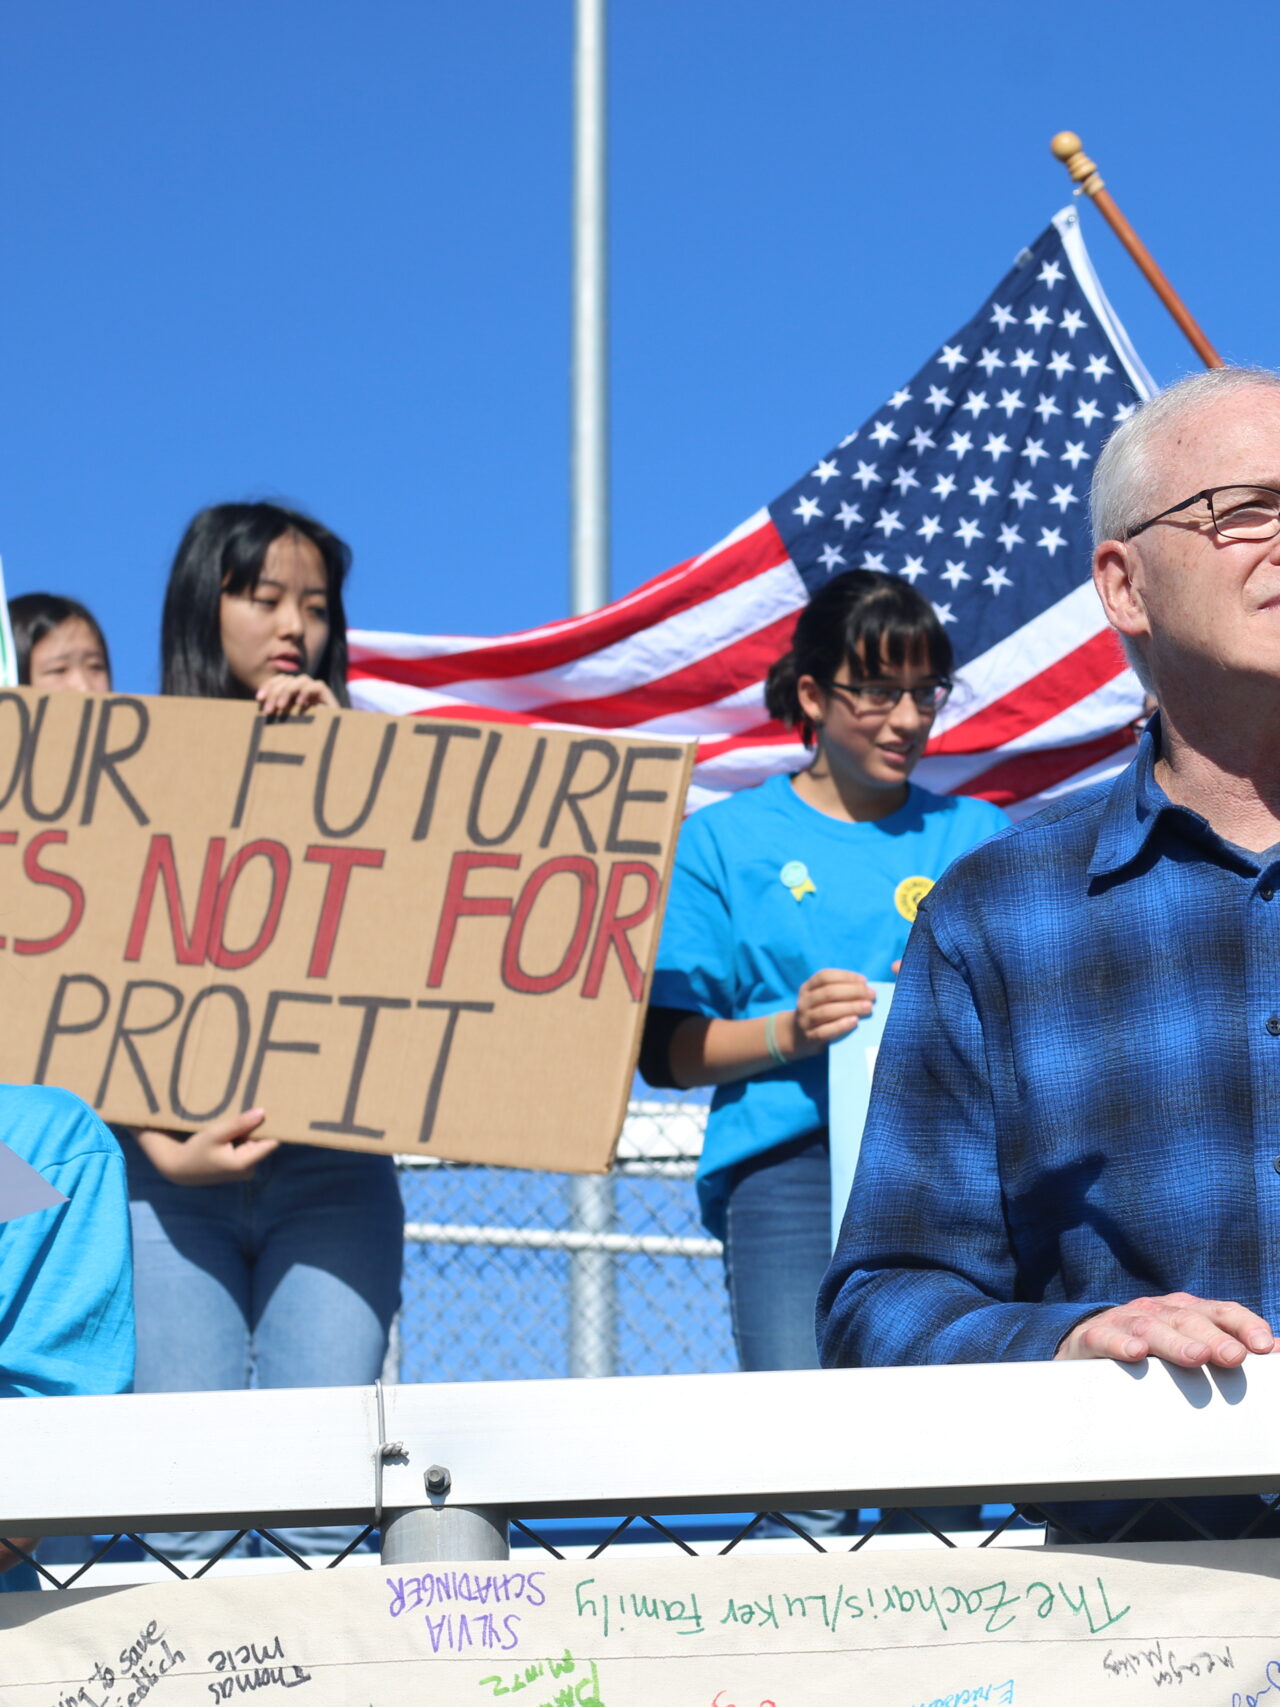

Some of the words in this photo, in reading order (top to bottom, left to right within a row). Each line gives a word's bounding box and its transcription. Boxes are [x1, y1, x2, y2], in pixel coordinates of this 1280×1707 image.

[230, 714, 684, 856] FUTURE
[0, 829, 86, 957] S
[123, 834, 386, 979] NOT
[426, 851, 660, 1002] FOR
[35, 973, 495, 1142] PROFIT
[387, 1571, 545, 1618] SCHADINGER
[576, 1578, 706, 1636] Family
[1028, 1577, 1131, 1634] The
[120, 1620, 165, 1674] save
[426, 1614, 521, 1652] SYLVIA
[208, 1665, 311, 1705] Thomas
